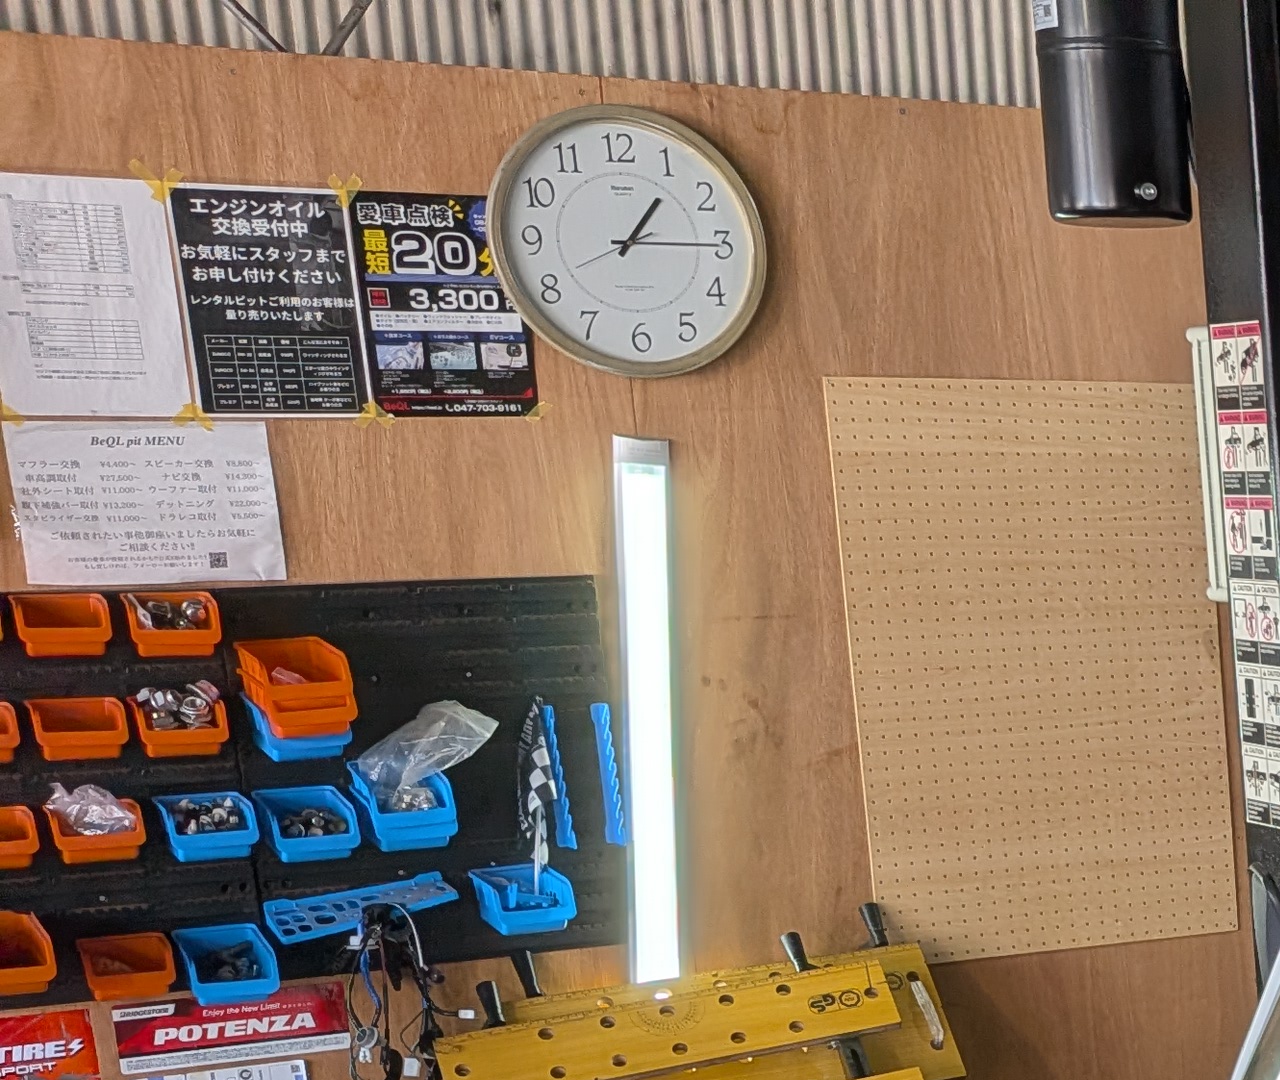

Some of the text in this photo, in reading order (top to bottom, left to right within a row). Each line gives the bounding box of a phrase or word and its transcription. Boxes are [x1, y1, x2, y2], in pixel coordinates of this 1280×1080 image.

[553, 143, 583, 173] 11
[601, 132, 636, 163] 12
[659, 147, 675, 177] 1
[522, 177, 555, 208] 10
[696, 181, 716, 211] 2
[189, 198, 325, 218] エンジンオイル
[356, 202, 454, 227] 愛車点検
[211, 217, 309, 238] 交換受付中
[521, 225, 542, 255] 9
[180, 244, 346, 263] お気軽にスタッフまで
[363, 229, 392, 275] 最短
[713, 230, 733, 260] 3
[191, 267, 342, 285] お申し付けください
[190, 295, 355, 308] レンタルピットご利用のお客様は
[540, 274, 561, 304] 8
[706, 276, 727, 307] 4
[225, 310, 324, 322] 量り売りいたします
[580, 310, 599, 341] 7
[678, 312, 697, 342] 5
[631, 323, 652, 353] 6
[90, 436, 186, 448] BeQL pit MENU
[17, 459, 81, 469] マフラー交換
[144, 459, 214, 468] スピーカー交換
[161, 472, 202, 482] ナビ交換
[21, 486, 94, 496] 社外シート取付
[148, 485, 218, 494] ウーファー取付
[158, 512, 217, 521] ドラレコ取付
[1248, 747, 1264, 755] CAUTION
[203, 1008, 224, 1017] Enjoy
[153, 1012, 316, 1046] POTENZA
[0, 1062, 57, 1078] PORT
